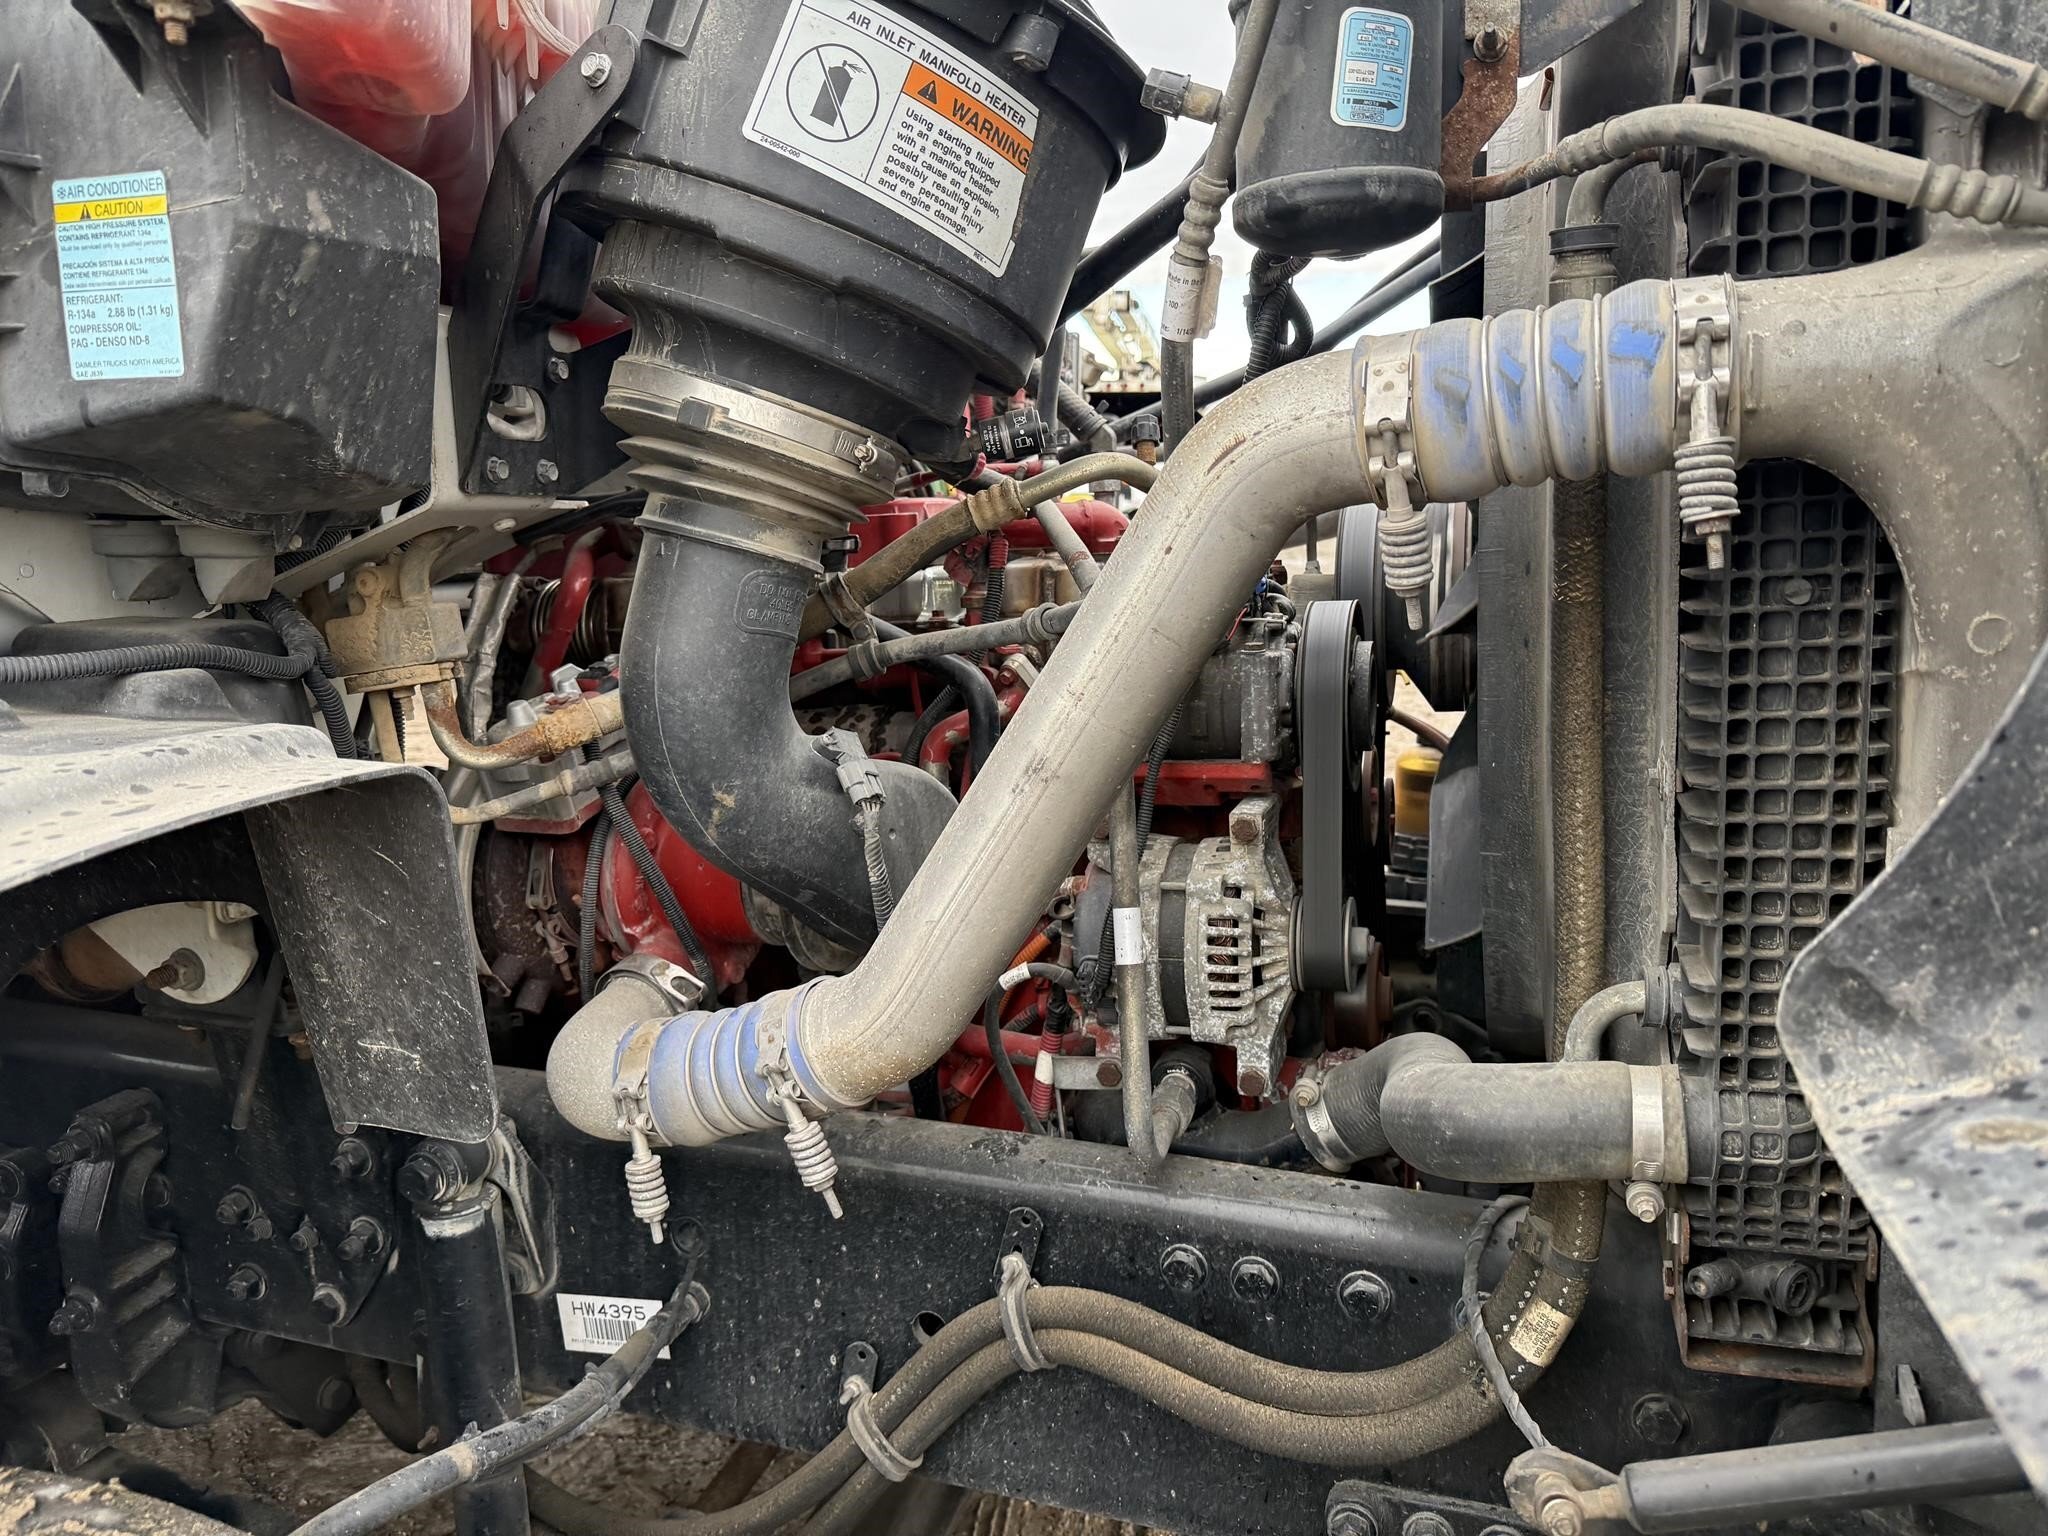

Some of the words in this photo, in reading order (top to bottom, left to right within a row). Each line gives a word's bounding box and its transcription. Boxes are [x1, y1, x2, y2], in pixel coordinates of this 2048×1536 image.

[847, 10, 871, 31] AIR
[876, 24, 915, 53] INLET
[918, 50, 982, 95] MANIFOLD
[985, 87, 1027, 128] HEATER
[905, 107, 934, 133] Using
[937, 127, 972, 156] starting
[975, 150, 995, 170] fluid
[950, 98, 1030, 166] WARNING
[896, 131, 916, 149] with
[918, 146, 926, 154] a
[928, 150, 966, 179] manifold
[968, 175, 994, 197] heater
[901, 120, 914, 132] on
[916, 130, 930, 142] an
[932, 138, 962, 163] engine
[964, 156, 1001, 188] equipped
[67, 185, 85, 199] AIR
[87, 177, 164, 197] CONDITIONER
[886, 154, 929, 183] possibly
[931, 180, 971, 211] resulting
[972, 205, 982, 217] in
[891, 143, 918, 163] could
[921, 160, 948, 180] cause
[950, 177, 962, 189] an
[963, 185, 1001, 219] explosion,
[94, 201, 144, 217] CAUTION
[878, 176, 898, 193] and
[900, 188, 932, 212] engine
[933, 209, 968, 236] damage.
[882, 165, 915, 188] severe
[918, 187, 958, 216] personal
[961, 211, 985, 233] injury
[59, 234, 89, 242] CONTAINS
[91, 231, 135, 240] REFRIGERANT
[85, 223, 100, 231] HIGH
[102, 221, 137, 229] PRESSURE
[63, 271, 91, 280] CONTIENE
[91, 269, 134, 278] REFRIGERANTE
[1182, 277, 1189, 286] in
[66, 293, 124, 305] REFRIGERANT:
[68, 309, 96, 320] R-134a
[107, 307, 125, 318] 2.88
[127, 307, 136, 317] lb
[137, 305, 158, 319] (1.31
[159, 304, 174, 317] kg)
[69, 322, 124, 334] COMPRESSOR
[125, 322, 142, 331] OIL:
[70, 338, 89, 349] PAG
[95, 336, 127, 348] DENSO
[128, 335, 150, 346] ND-8
[75, 360, 102, 369] DAIMLER
[102, 359, 128, 367] TRUCKS
[151, 357, 180, 365] AMERICA
[571, 1300, 647, 1321] HW4395
